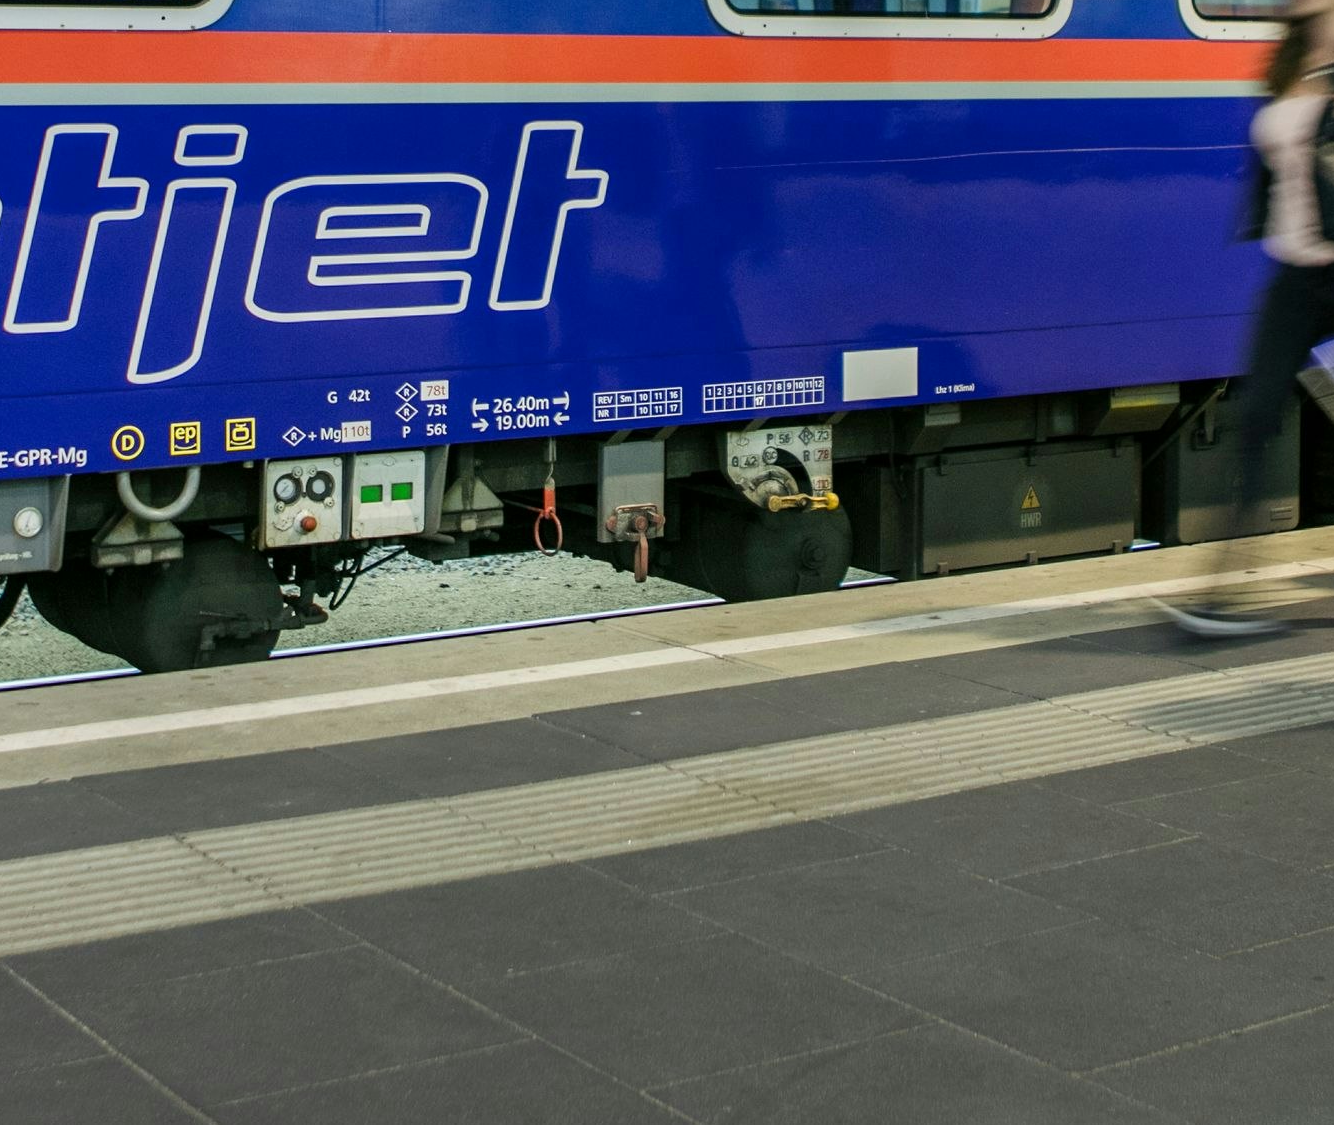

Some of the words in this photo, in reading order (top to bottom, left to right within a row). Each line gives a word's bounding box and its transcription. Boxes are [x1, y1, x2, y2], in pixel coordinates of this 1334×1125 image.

[328, 391, 337, 403] G
[349, 390, 370, 402] 42t
[426, 385, 447, 397] 78t
[598, 396, 613, 404] REV
[655, 392, 662, 400] 11
[669, 390, 678, 399] 16
[427, 404, 447, 416] 73t
[493, 396, 549, 414] 26.40m
[598, 409, 609, 417] NR
[655, 405, 663, 414] 11
[495, 414, 549, 430] 19.00m
[175, 426, 196, 443] ep
[321, 428, 341, 442] Mg
[403, 426, 411, 438] P
[427, 424, 447, 436] 56t
[122, 435, 134, 451] D
